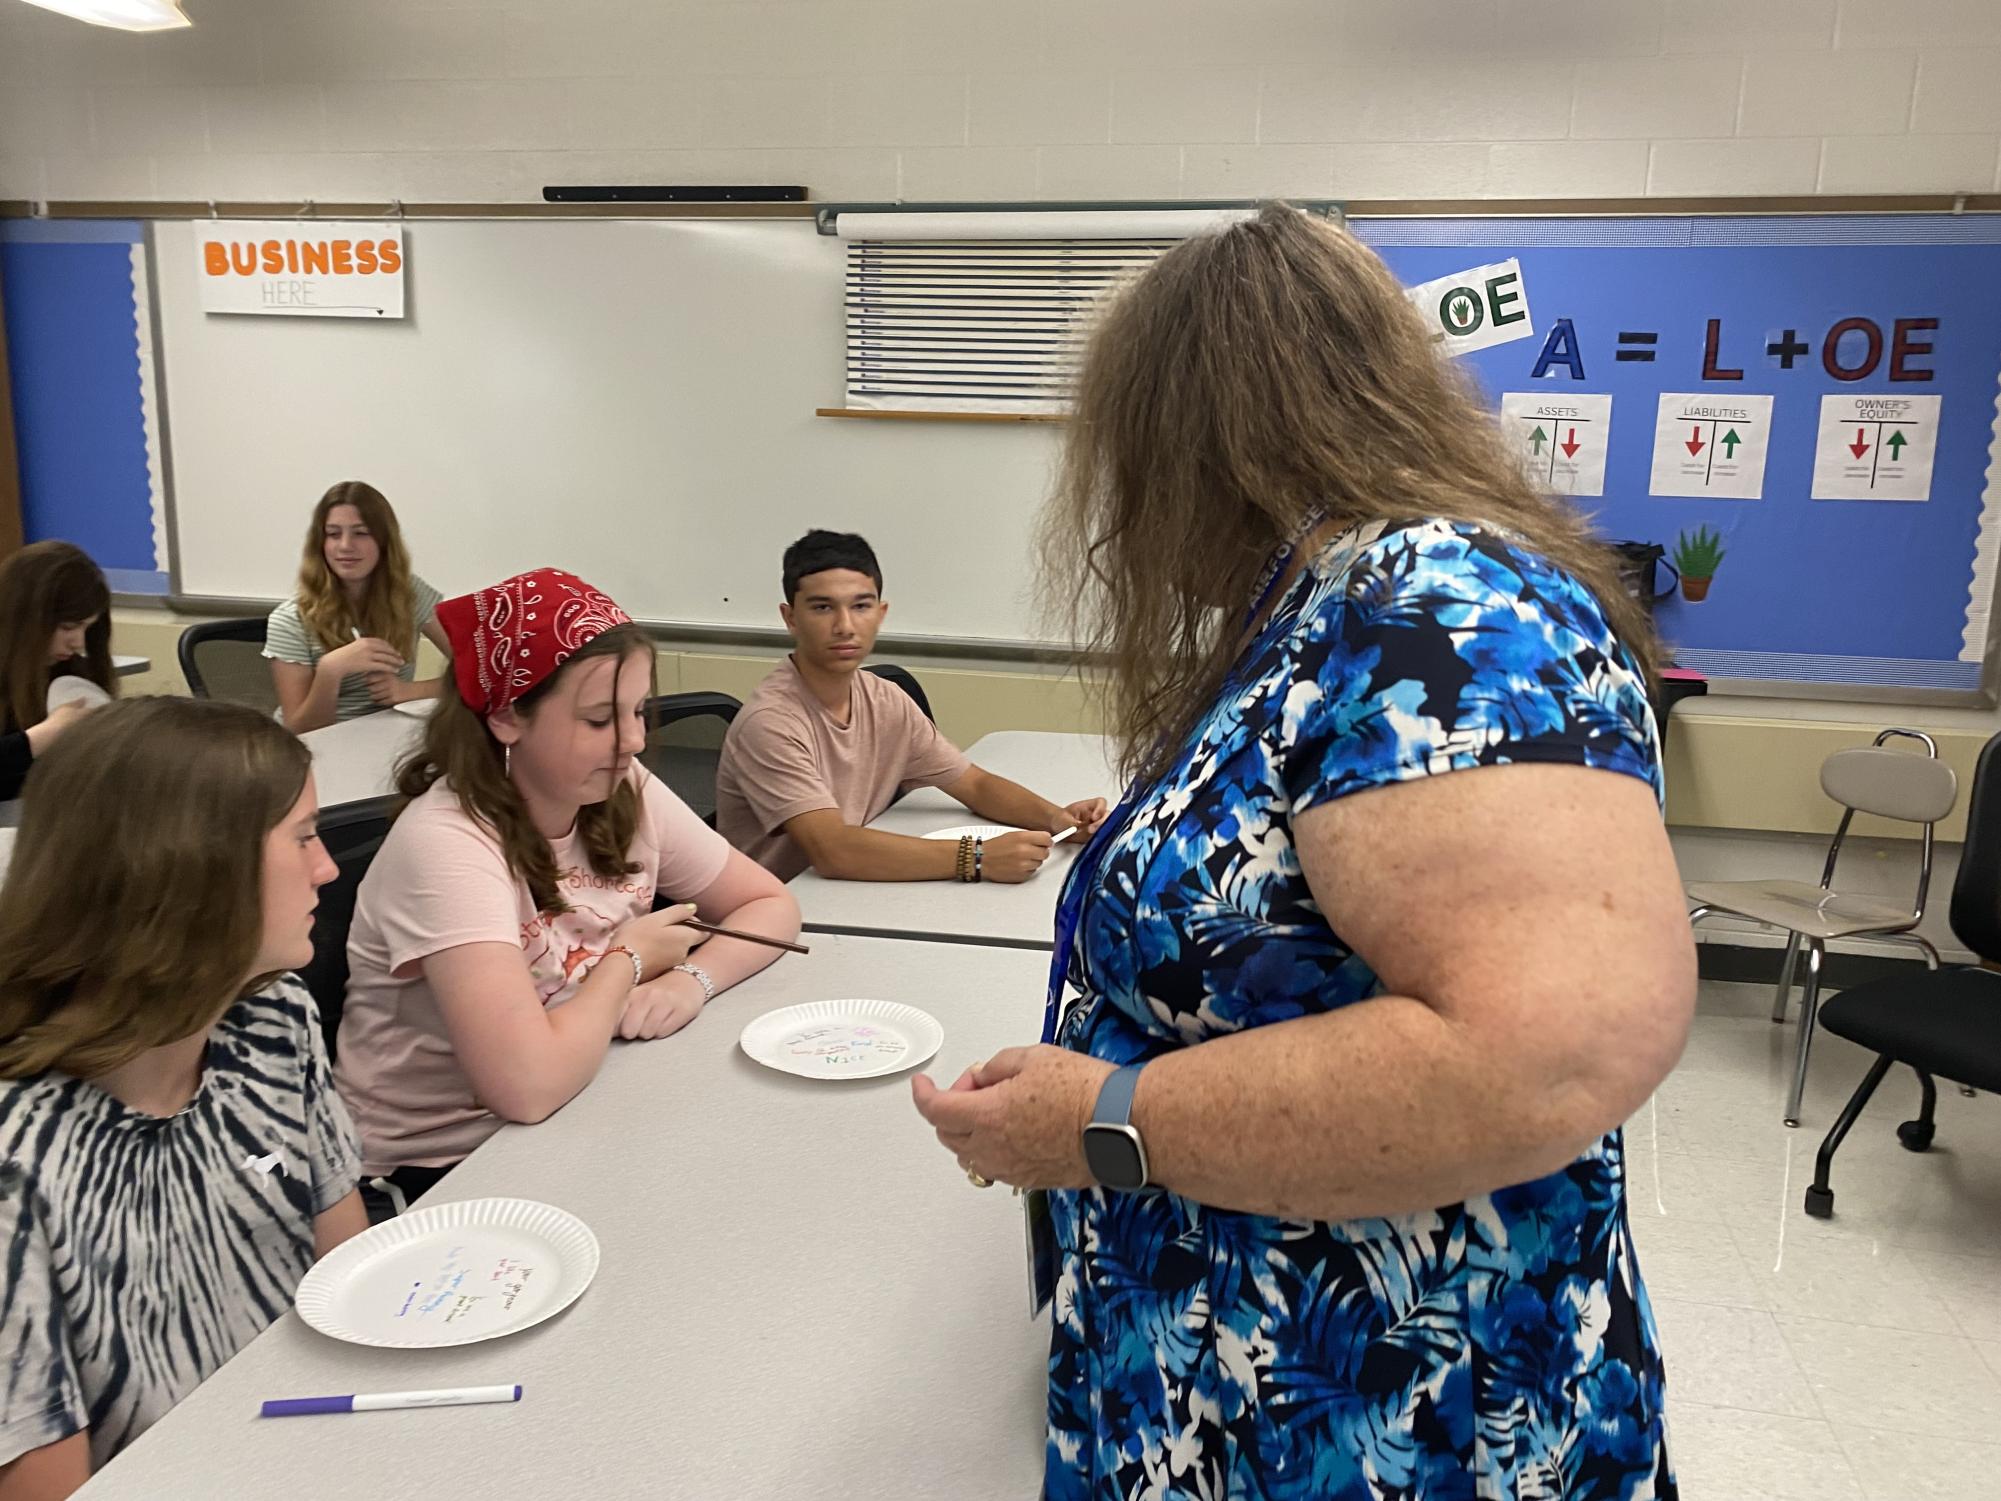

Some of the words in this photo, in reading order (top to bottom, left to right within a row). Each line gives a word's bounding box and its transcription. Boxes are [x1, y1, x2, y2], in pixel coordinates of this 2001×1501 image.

[204, 239, 401, 276] BUSINESS
[262, 281, 317, 305] HERE
[1439, 272, 1525, 337] OE
[1531, 318, 1586, 380] A
[1616, 332, 1658, 362] =
[1702, 319, 1744, 380] L
[1822, 317, 1940, 382] OE
[1537, 406, 1578, 417] ASSETS
[1683, 406, 1747, 418] LIABILITIES
[1855, 399, 1912, 410] OWNER'S
[1860, 409, 1904, 419] EQUITY
